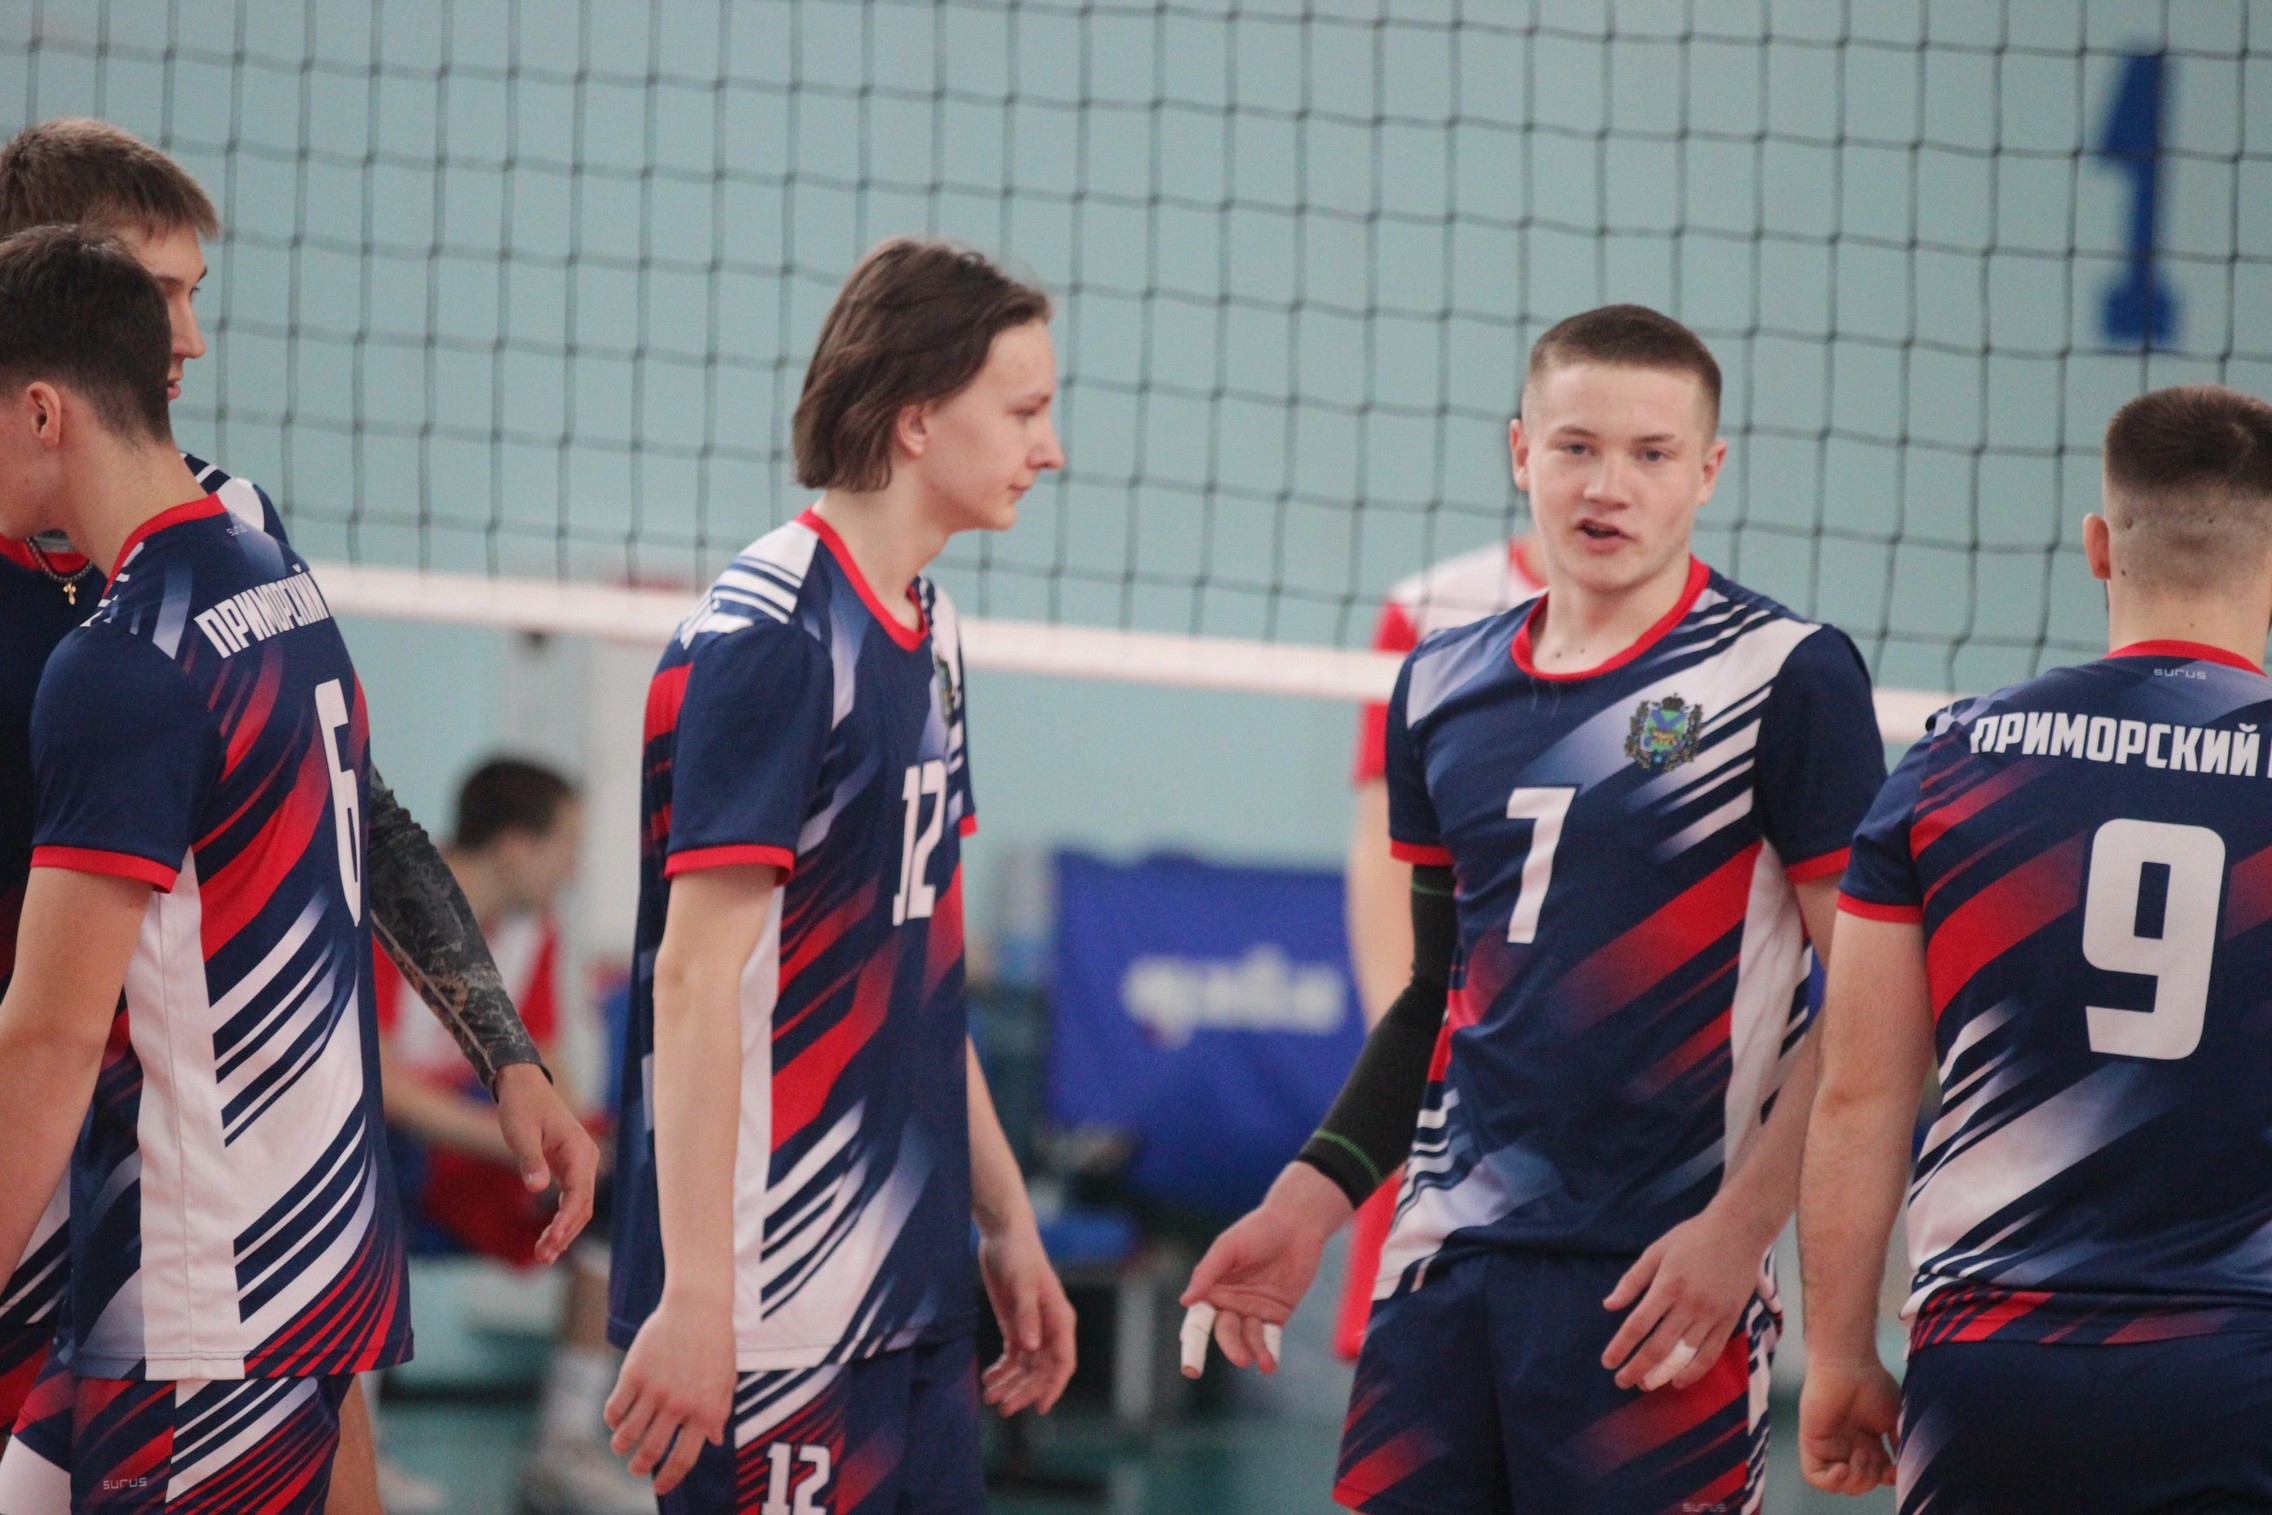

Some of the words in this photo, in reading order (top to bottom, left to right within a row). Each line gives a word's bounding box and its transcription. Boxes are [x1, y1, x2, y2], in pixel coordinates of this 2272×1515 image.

[2153, 668, 2207, 680] surus
[1970, 711, 2260, 777] ПРИМОРСКИЙ
[315, 678, 361, 927] 6
[893, 759, 947, 926] 12
[1506, 787, 1576, 944] 7
[2082, 818, 2226, 1061] 9
[103, 1477, 148, 1490] surus
[761, 1442, 831, 1515] 12
